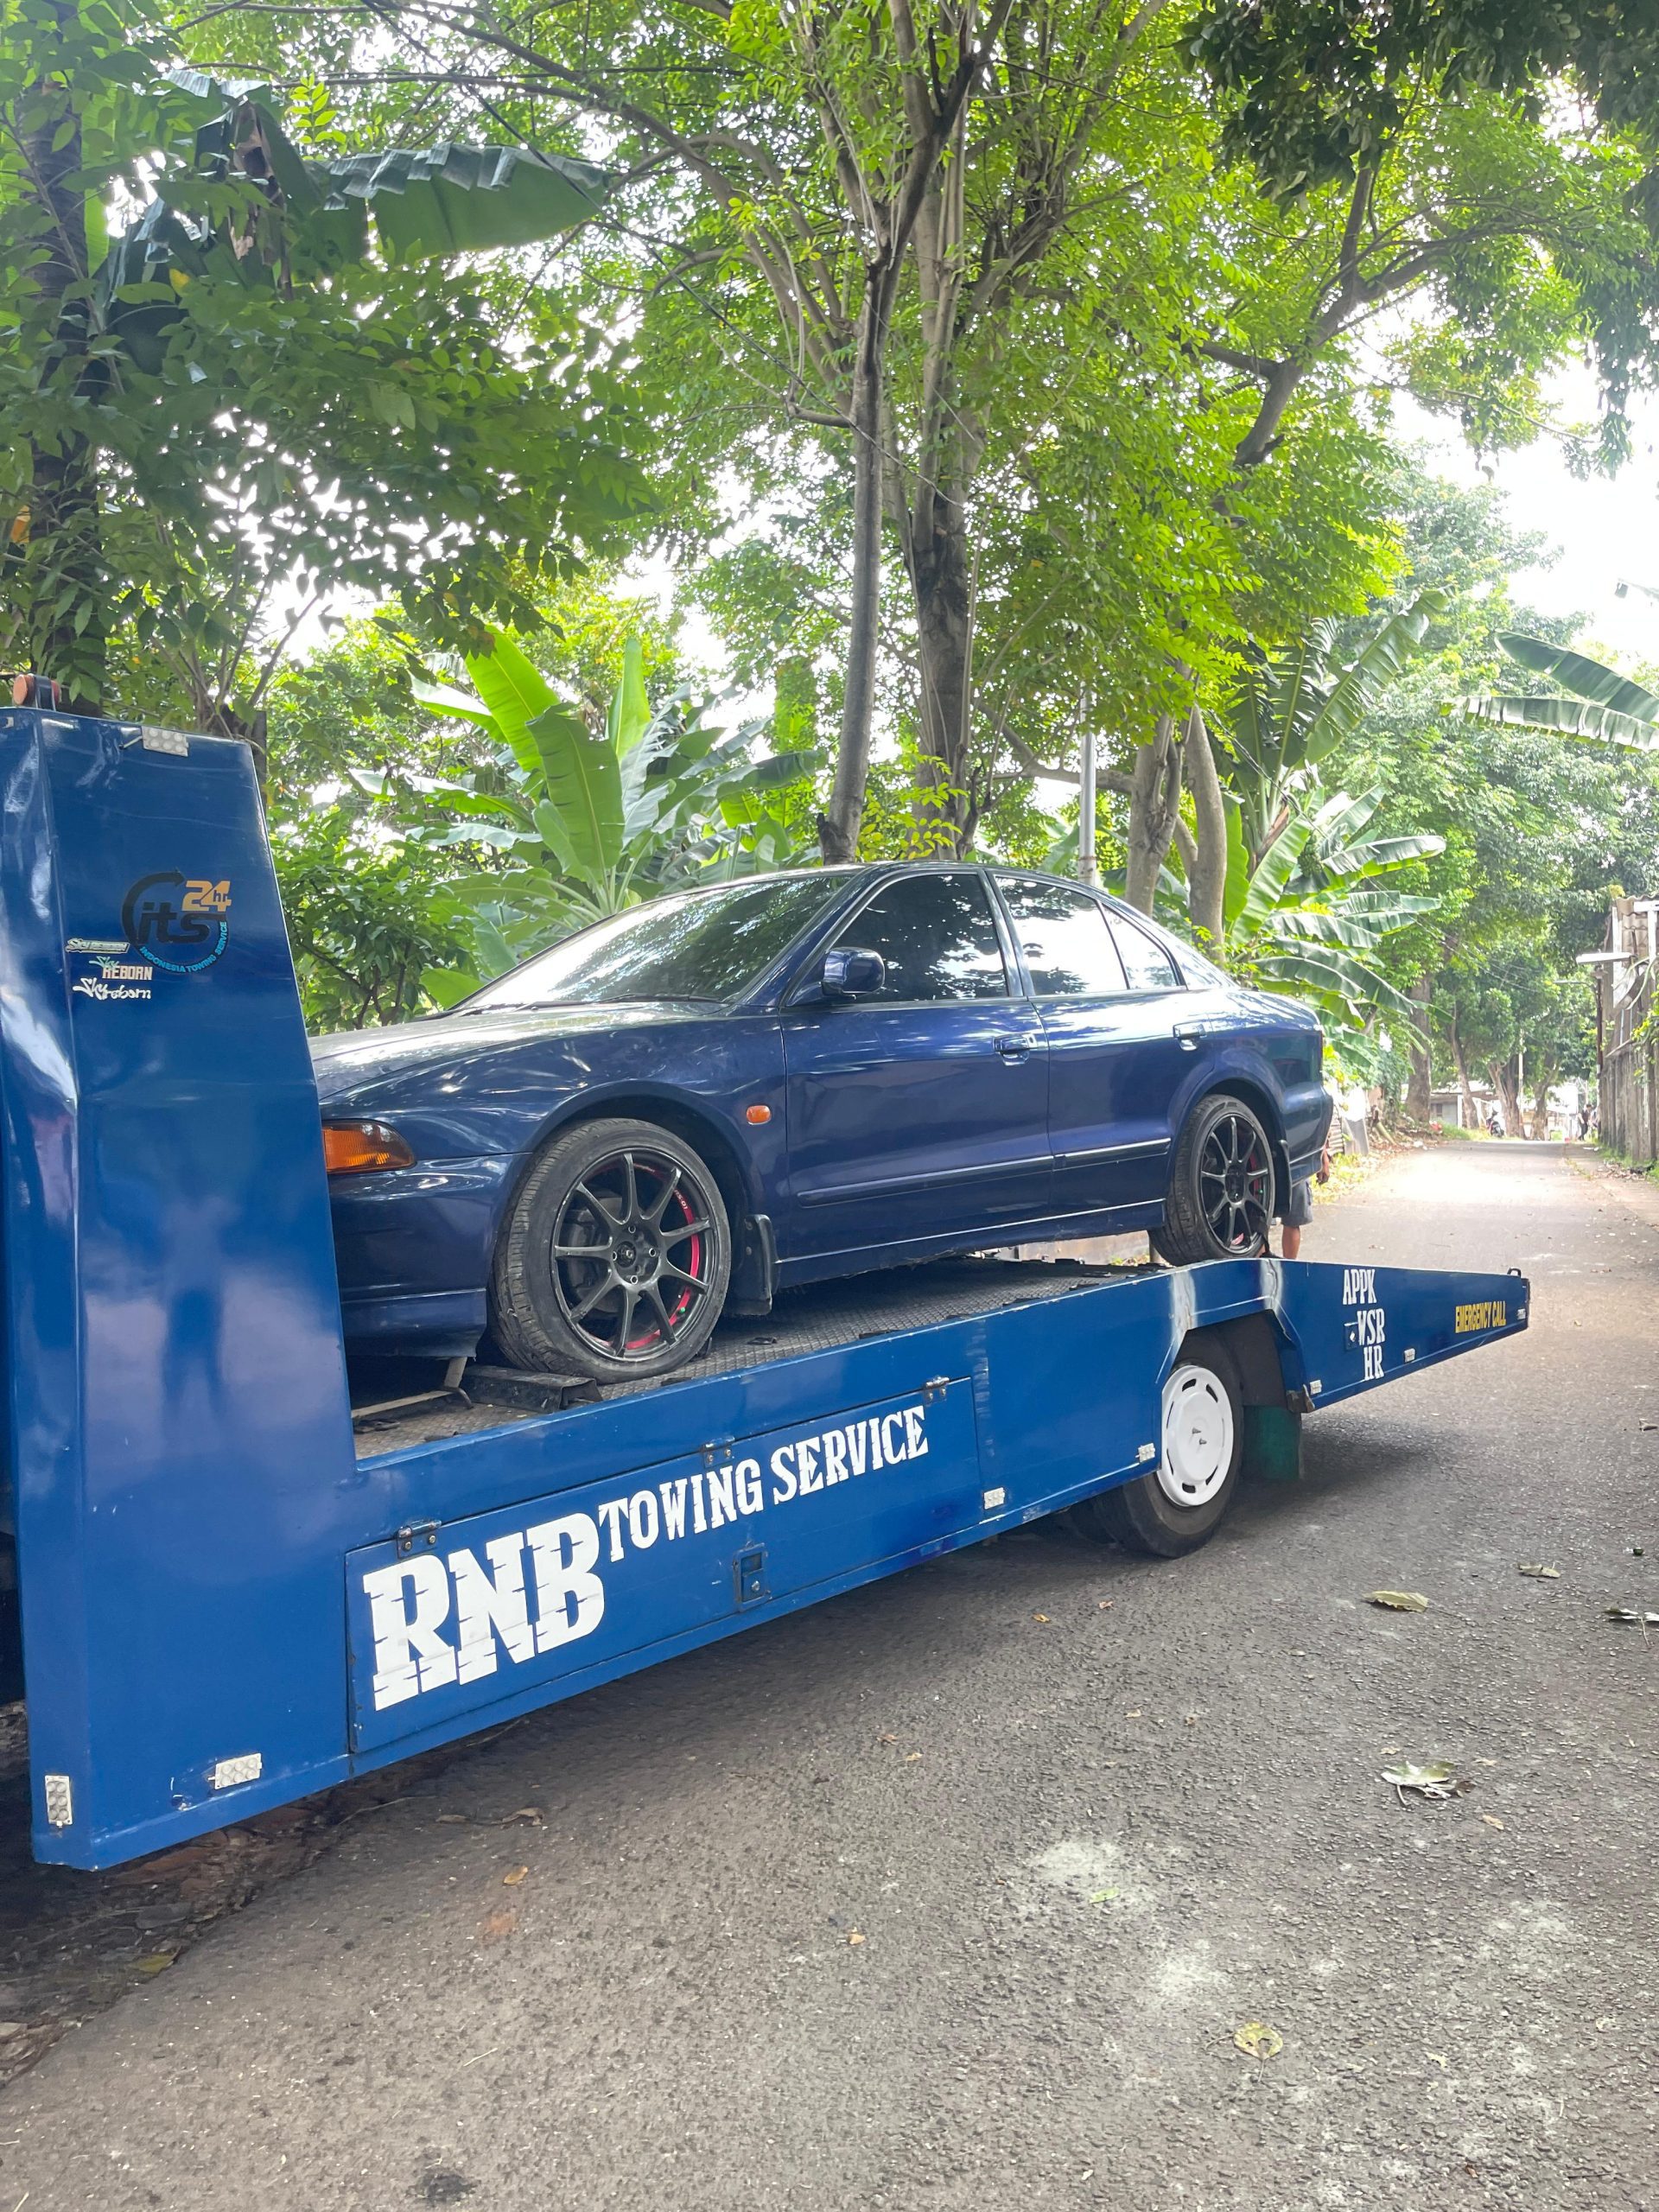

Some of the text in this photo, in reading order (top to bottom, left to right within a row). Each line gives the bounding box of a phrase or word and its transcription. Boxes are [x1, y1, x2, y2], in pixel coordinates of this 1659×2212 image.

[181, 880, 232, 912] 24
[139, 946, 187, 973] INDONESIA
[185, 954, 217, 973] TOWING
[214, 921, 228, 956] SERVICE
[102, 965, 153, 981] REBORN
[1343, 1268, 1377, 1306] APPK
[1455, 1300, 1507, 1333] EMERGENCY CALL
[1363, 1344, 1384, 1382] HR
[363, 1405, 929, 1711] RNB TOWING SERVICE
